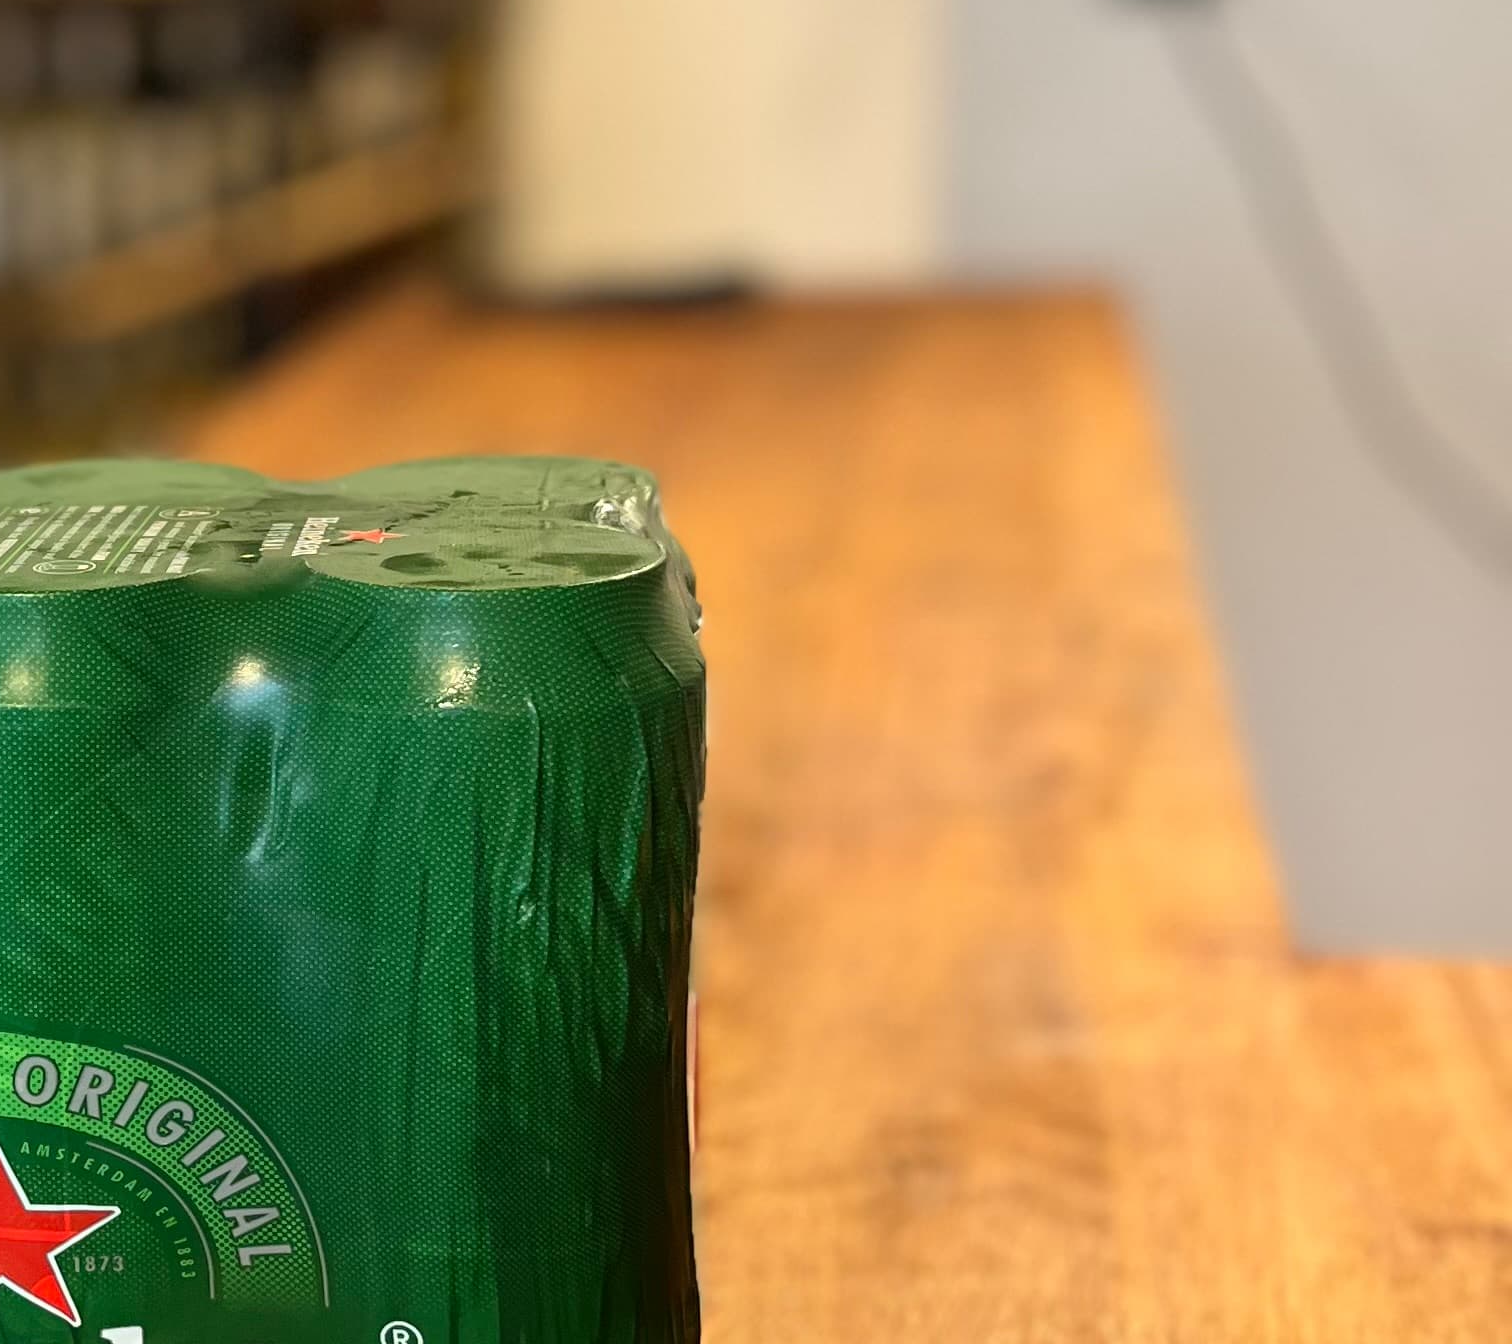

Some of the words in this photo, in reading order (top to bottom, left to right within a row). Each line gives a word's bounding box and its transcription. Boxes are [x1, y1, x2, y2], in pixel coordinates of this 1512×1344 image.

[12, 1055, 292, 1268] ORIGINAL
[20, 1141, 153, 1204] AMSTERDAM
[155, 1206, 177, 1229] EN
[174, 1237, 197, 1279] 1883
[72, 1255, 125, 1273] 1873
